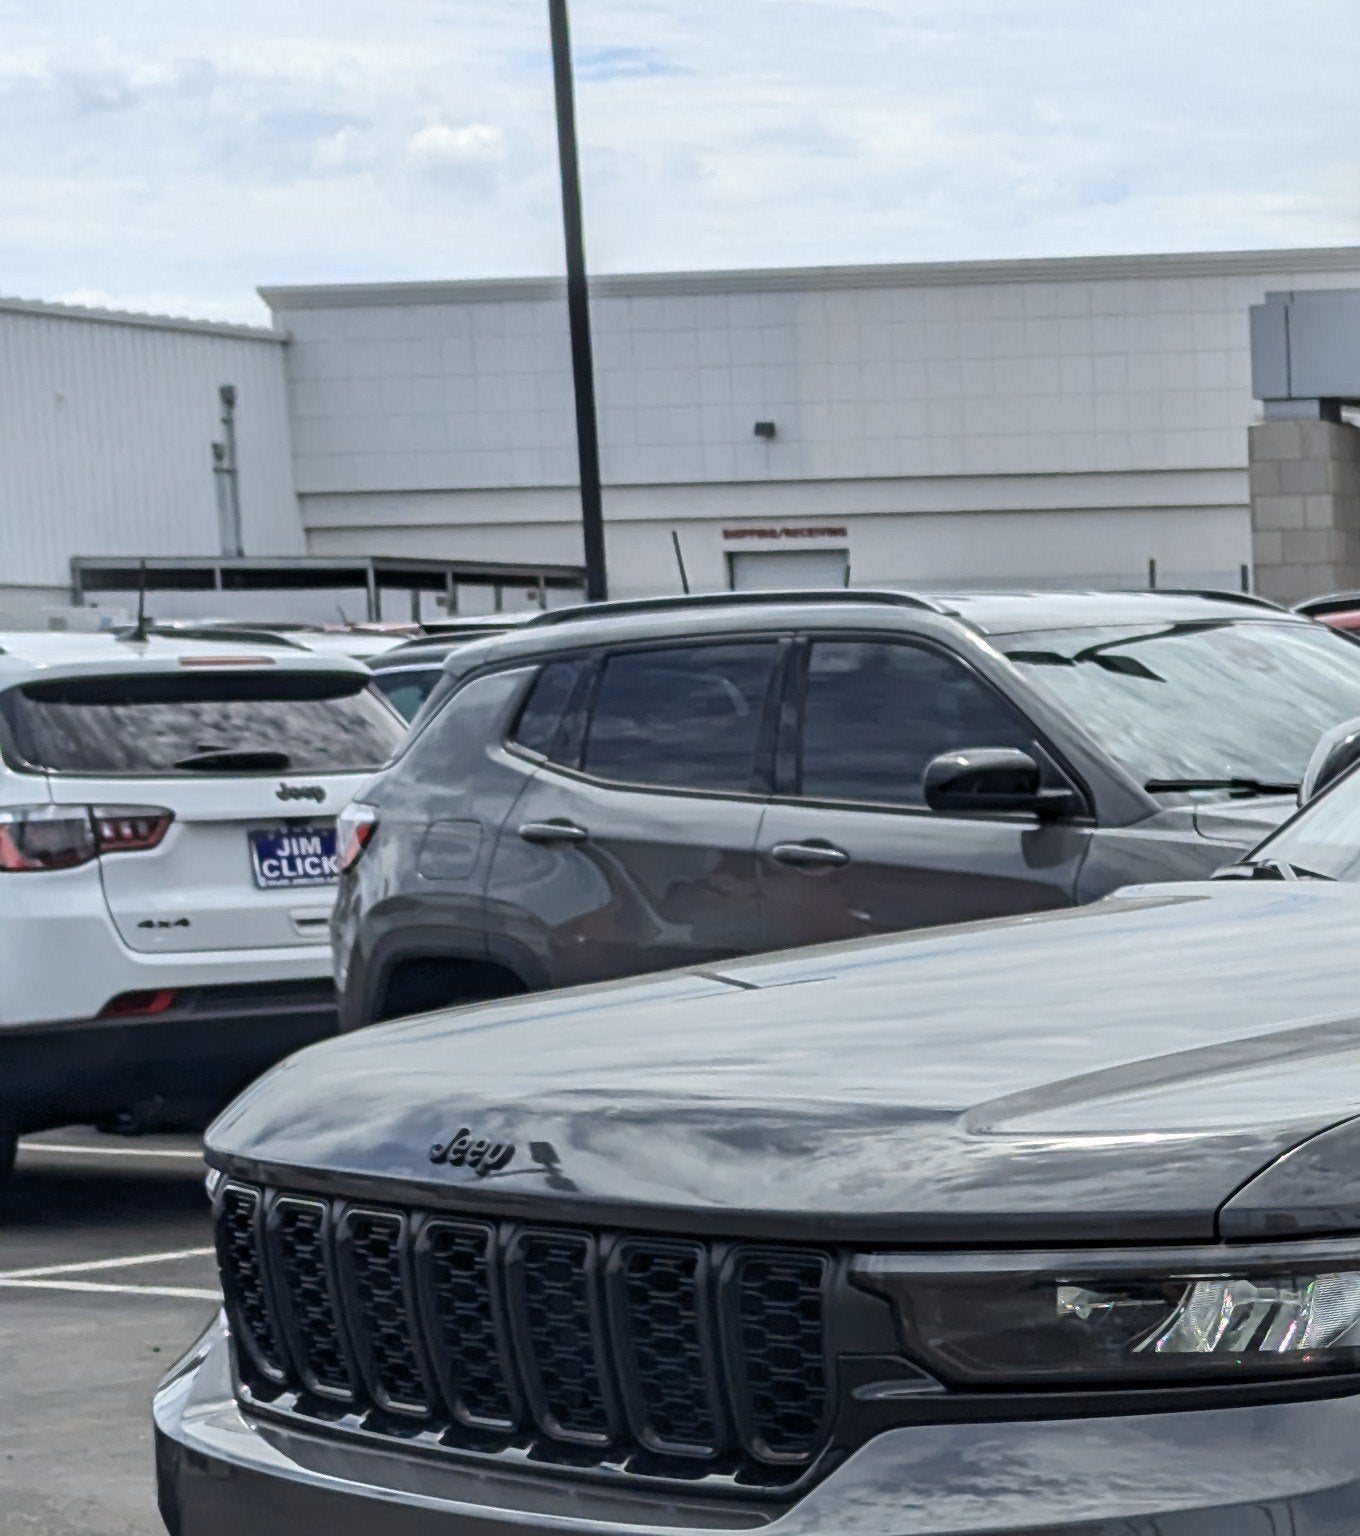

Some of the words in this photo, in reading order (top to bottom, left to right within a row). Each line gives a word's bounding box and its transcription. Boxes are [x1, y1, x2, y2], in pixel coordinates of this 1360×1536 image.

[276, 836, 323, 857] JIM
[262, 856, 340, 878] CLICK
[429, 1127, 516, 1177] Jeep
